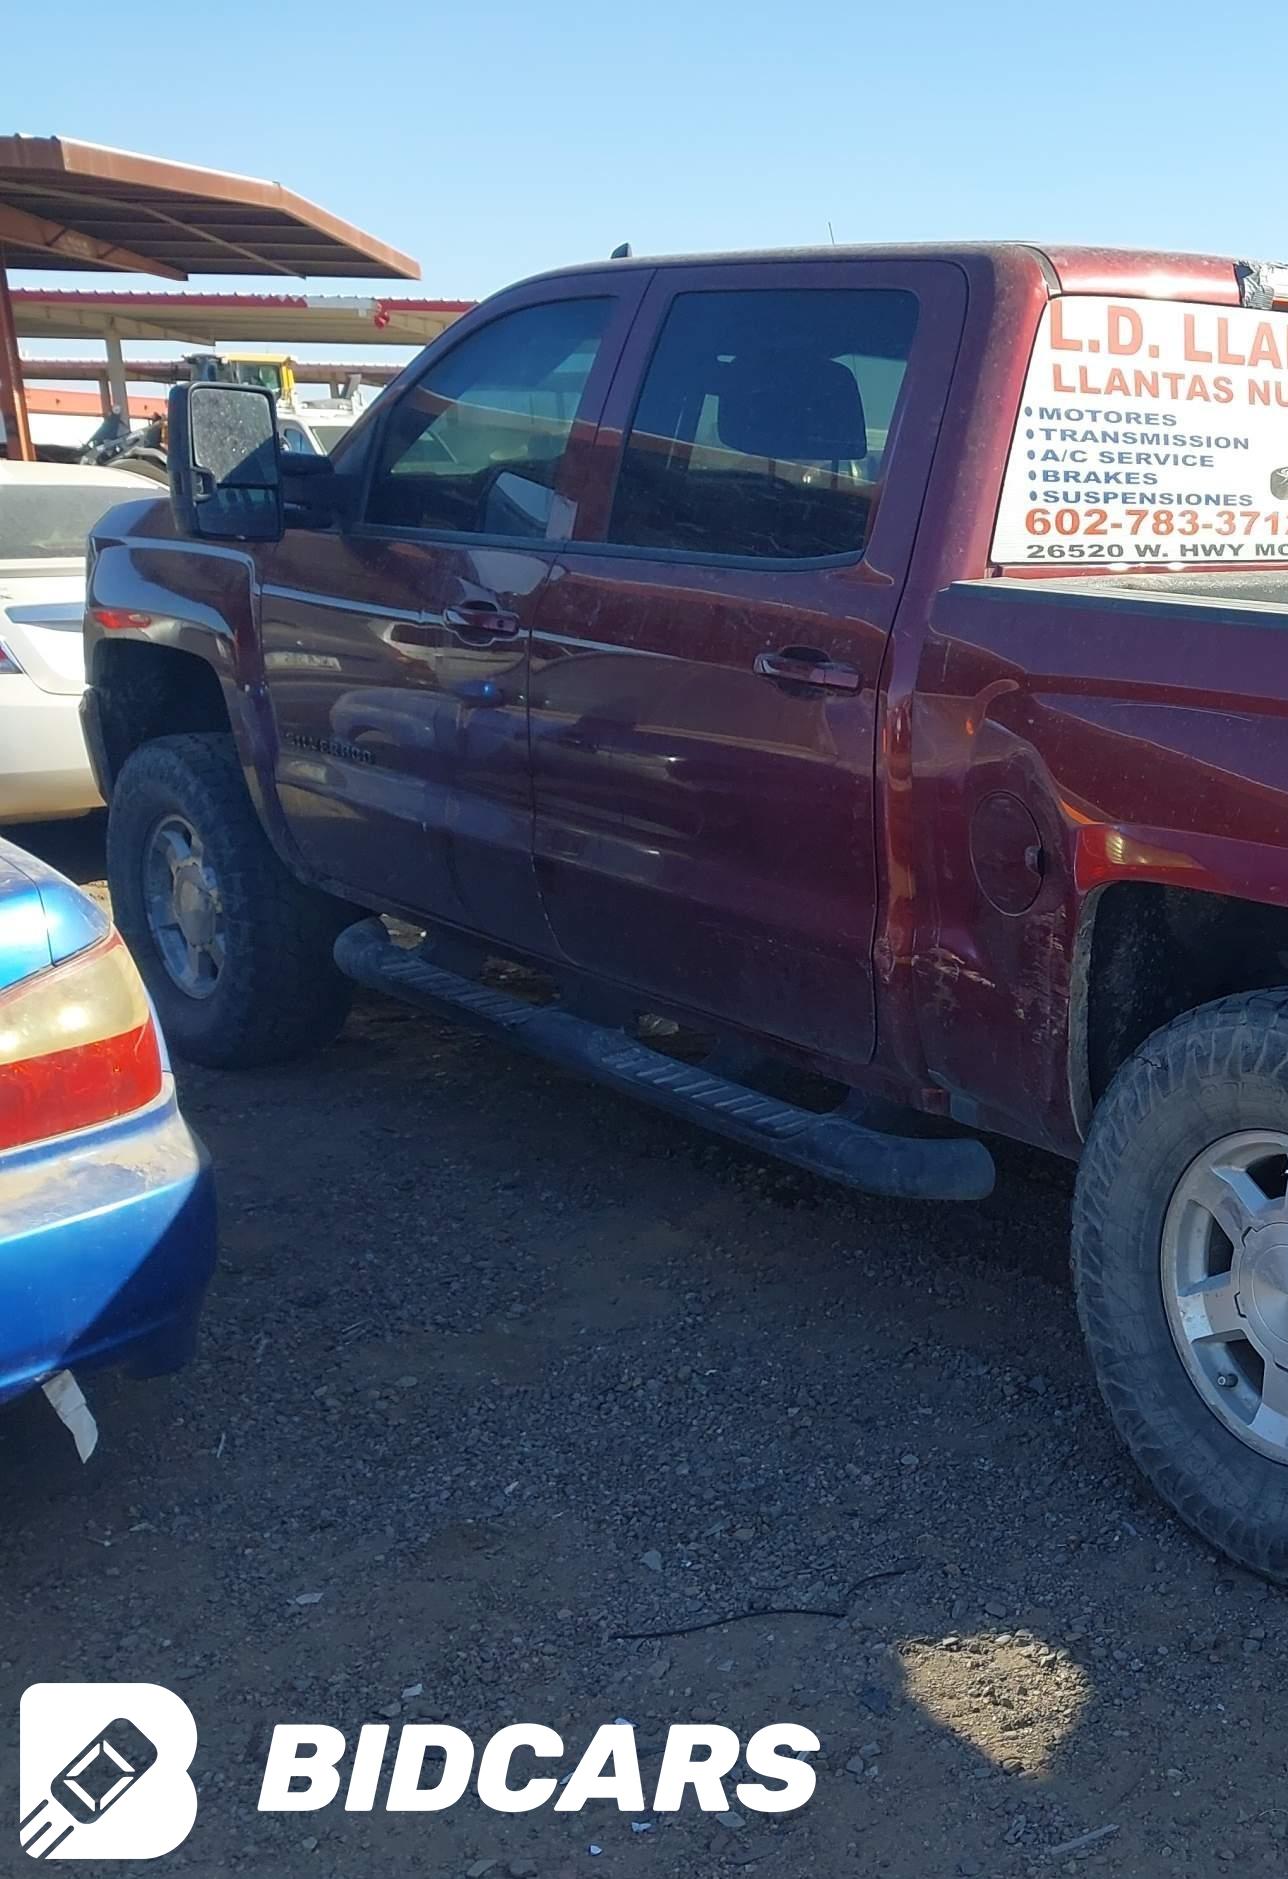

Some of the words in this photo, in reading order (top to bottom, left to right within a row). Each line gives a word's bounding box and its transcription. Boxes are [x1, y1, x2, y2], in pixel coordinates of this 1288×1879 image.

[1049, 300, 1160, 359] L.D.
[1052, 363, 1234, 403] LLANTAS
[1038, 407, 1177, 427] MOTORES
[1039, 428, 1249, 450] TRANSMISSION
[1040, 448, 1088, 463] A/C
[1098, 451, 1215, 468] SERVICE
[1041, 469, 1158, 485] BRAKES
[1042, 490, 1254, 507] SUSPENSIONES
[1026, 543, 1124, 559] 26520
[1134, 543, 1168, 558] W.
[1180, 543, 1245, 557] HWY
